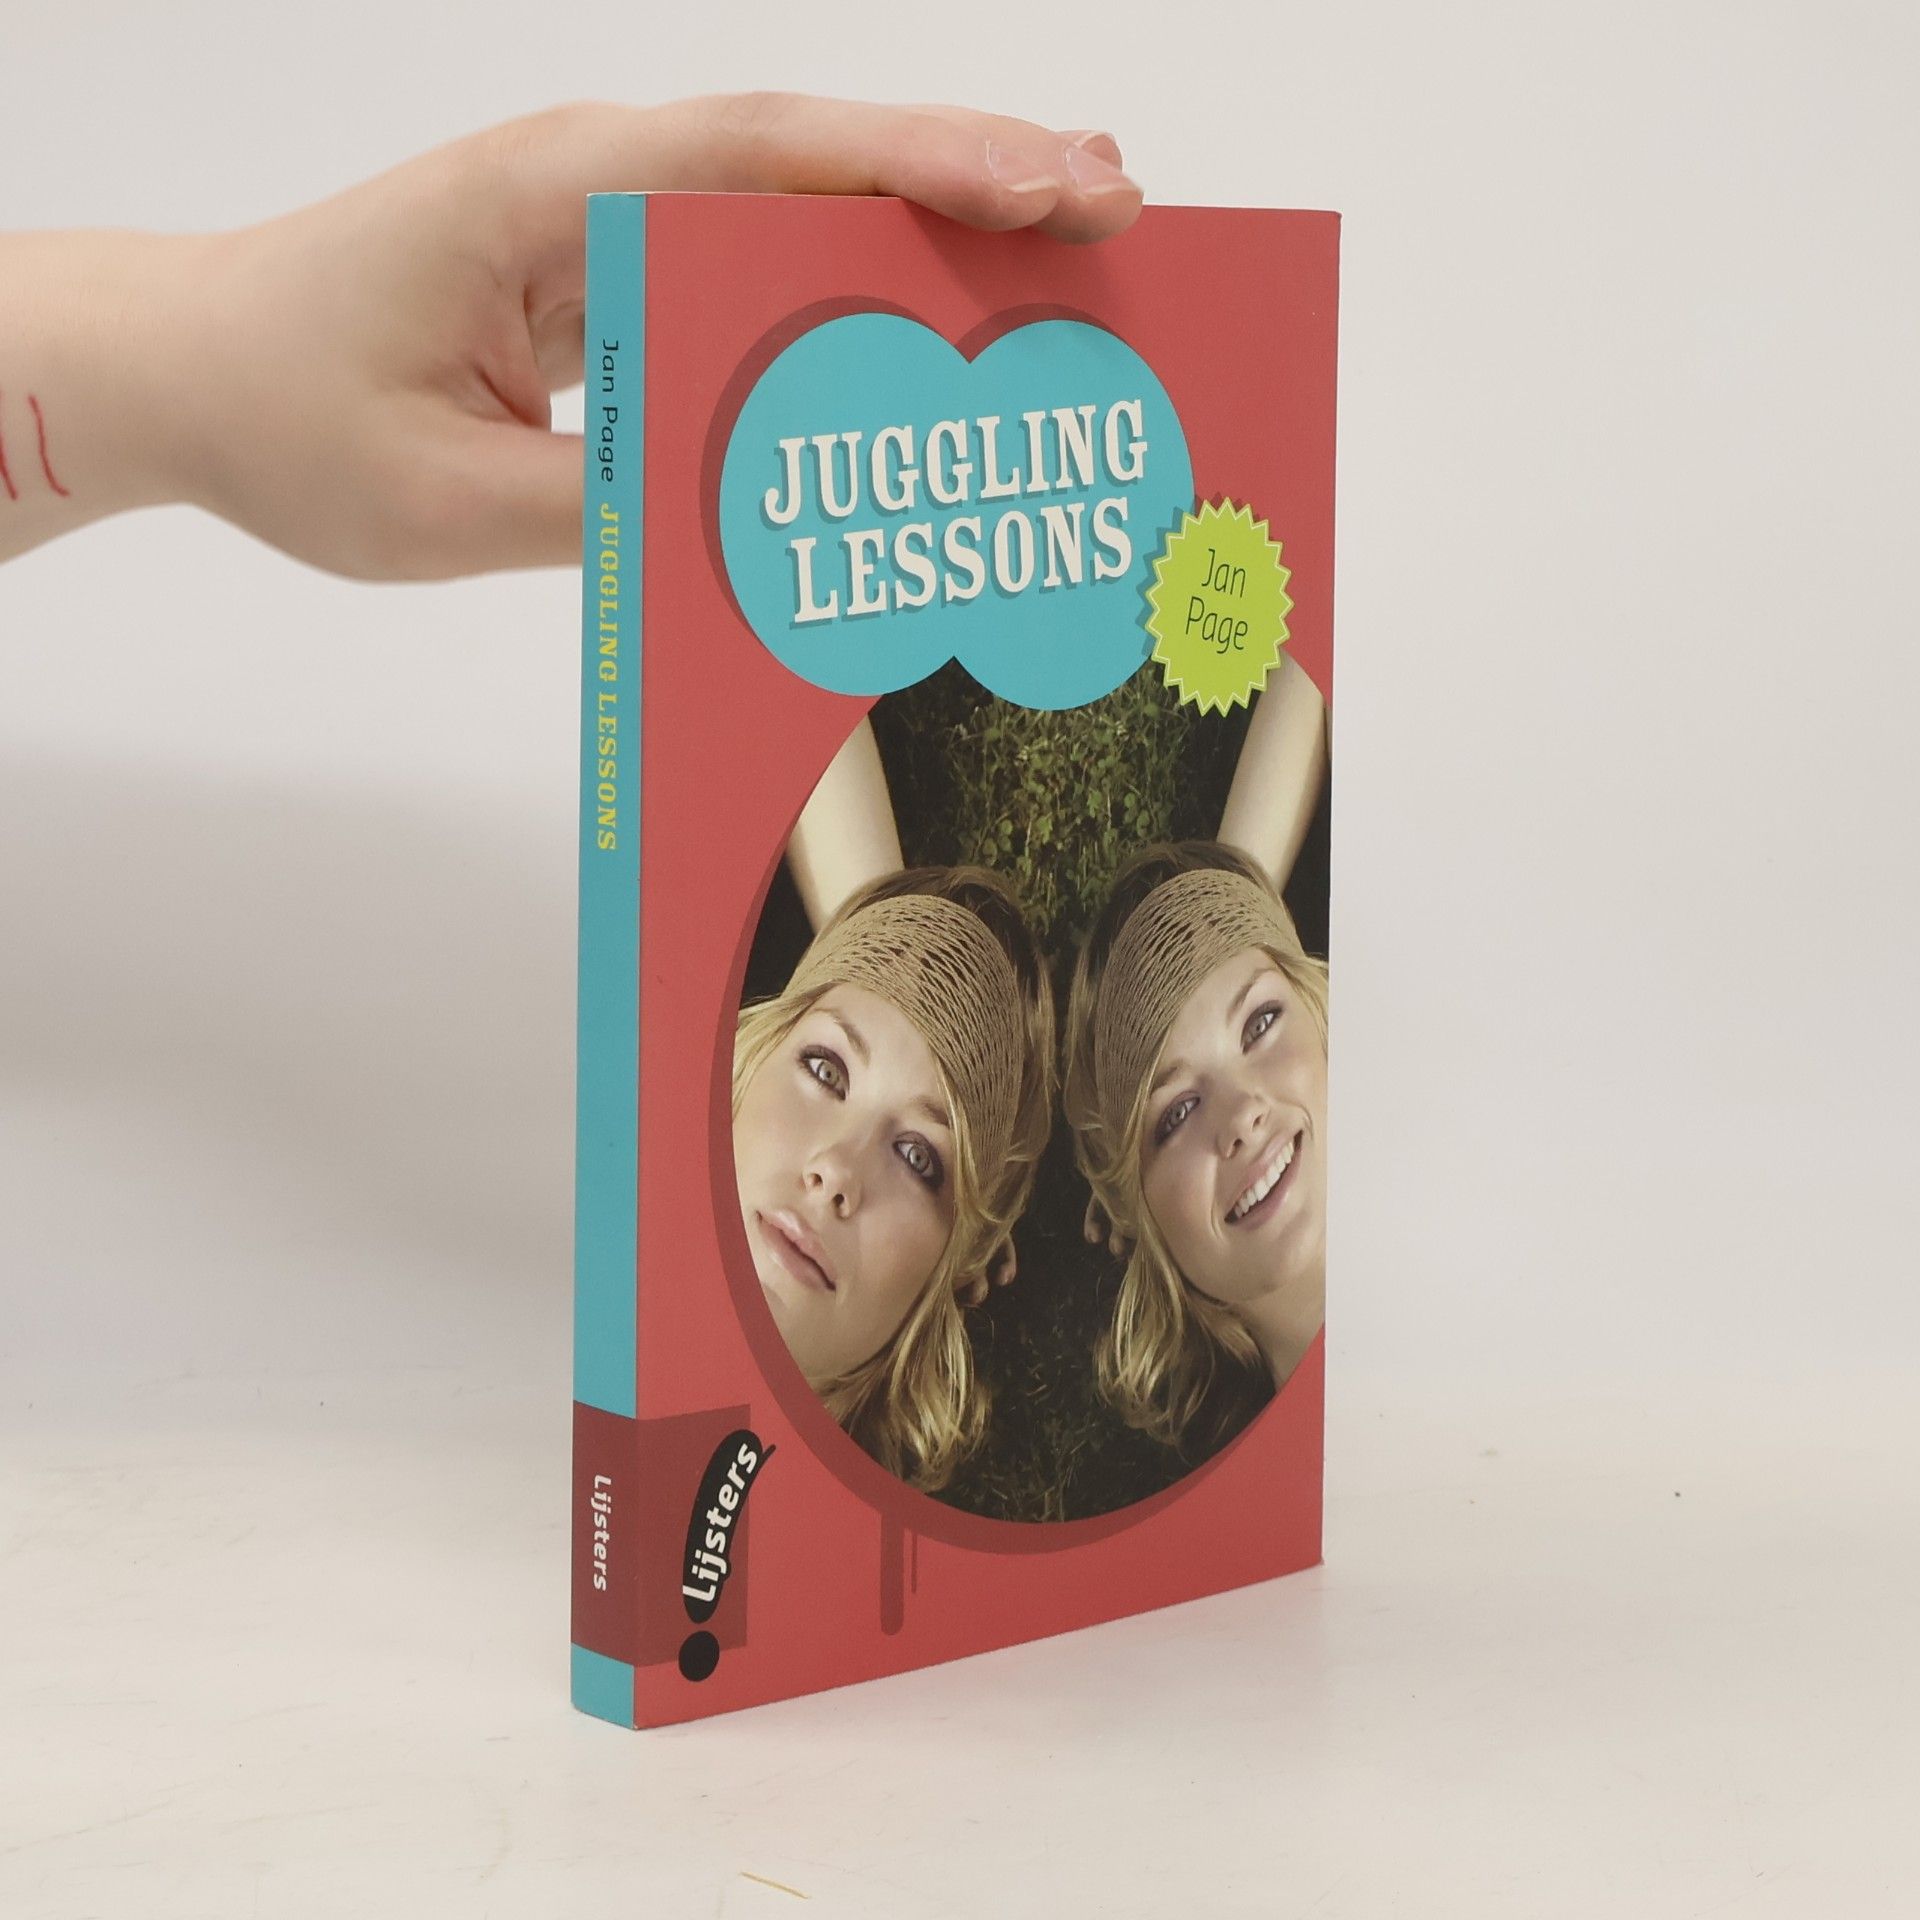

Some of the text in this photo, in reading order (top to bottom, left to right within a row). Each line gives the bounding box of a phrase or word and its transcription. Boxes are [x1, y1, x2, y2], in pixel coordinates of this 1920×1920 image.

[598, 339, 619, 483] Jan Page
[764, 399, 1148, 524] JUGGLING
[791, 497, 1132, 623] LESSONS
[1201, 548, 1246, 598] Jan
[597, 503, 620, 850] JUGGLING LESSONS
[1185, 596, 1248, 654] Page
[590, 1474, 612, 1592] Lijsters
[682, 1443, 759, 1602] Lijsters
